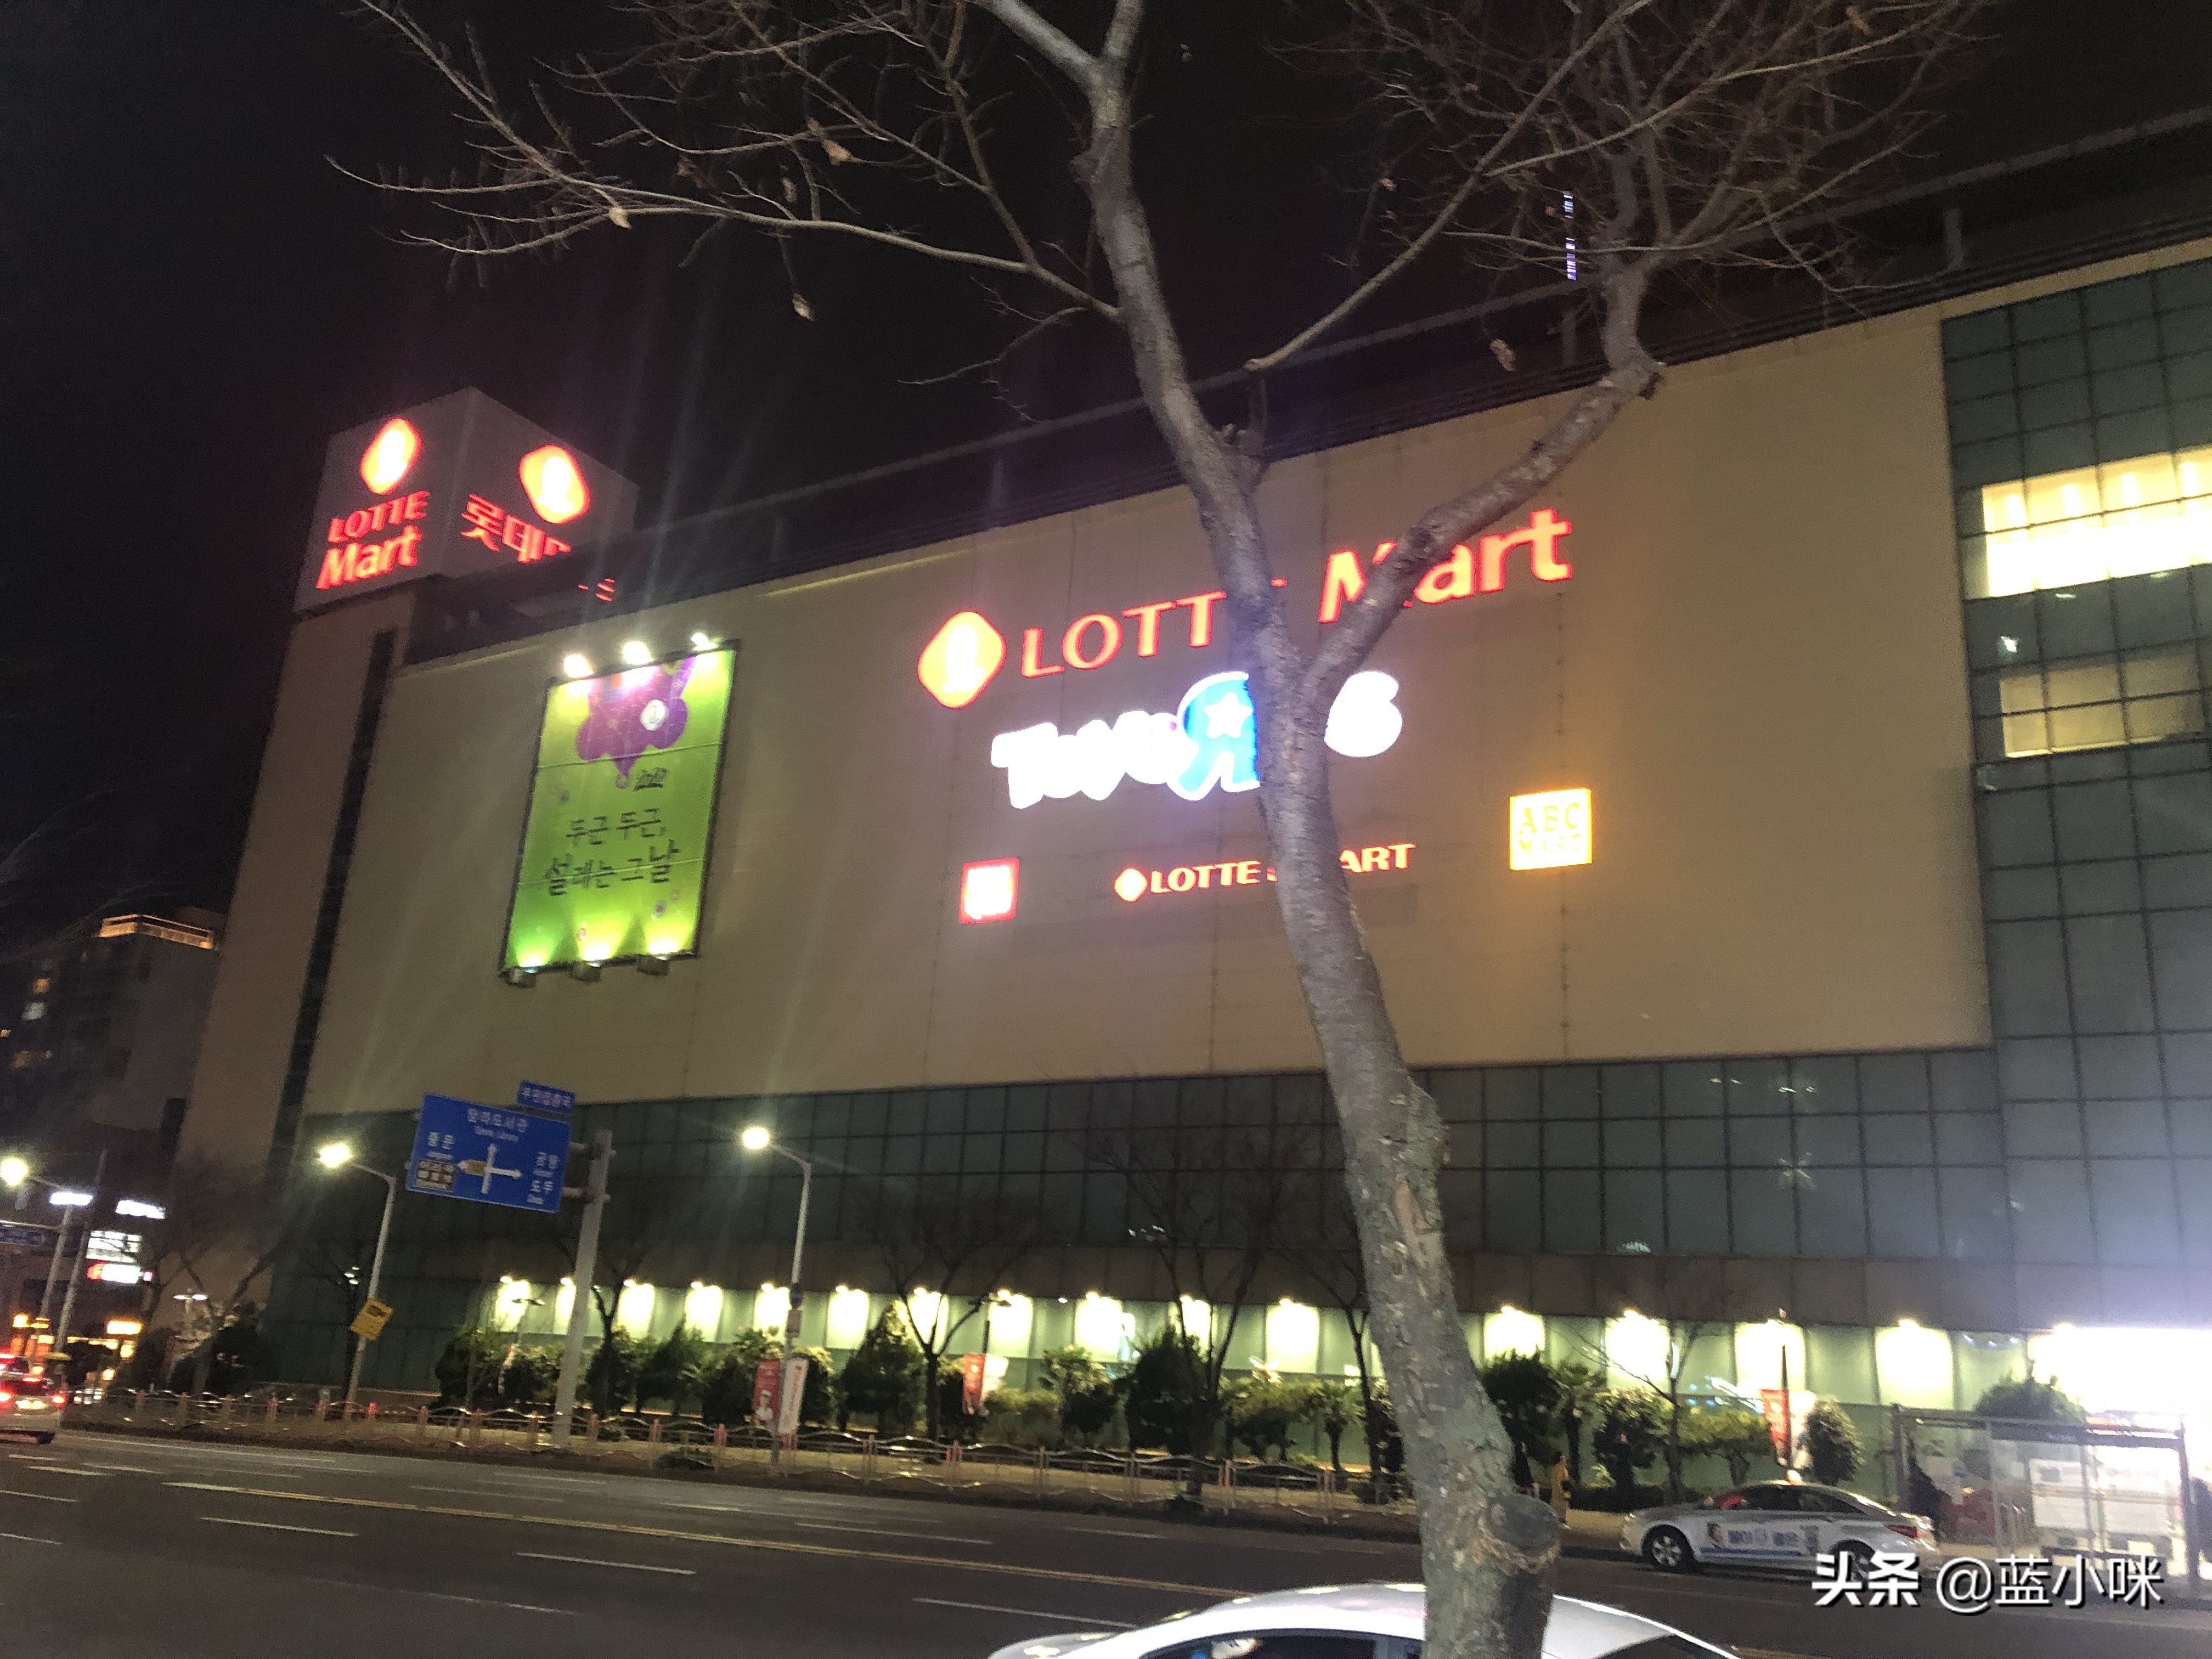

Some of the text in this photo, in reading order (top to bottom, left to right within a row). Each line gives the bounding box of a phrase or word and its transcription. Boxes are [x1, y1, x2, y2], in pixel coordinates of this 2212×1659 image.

[328, 491, 430, 543] LOTTE
[316, 524, 422, 589] Mart
[1021, 578, 1287, 678] LOTT
[1517, 803, 1580, 834] ABC
[1151, 860, 1261, 894] LOTTE
